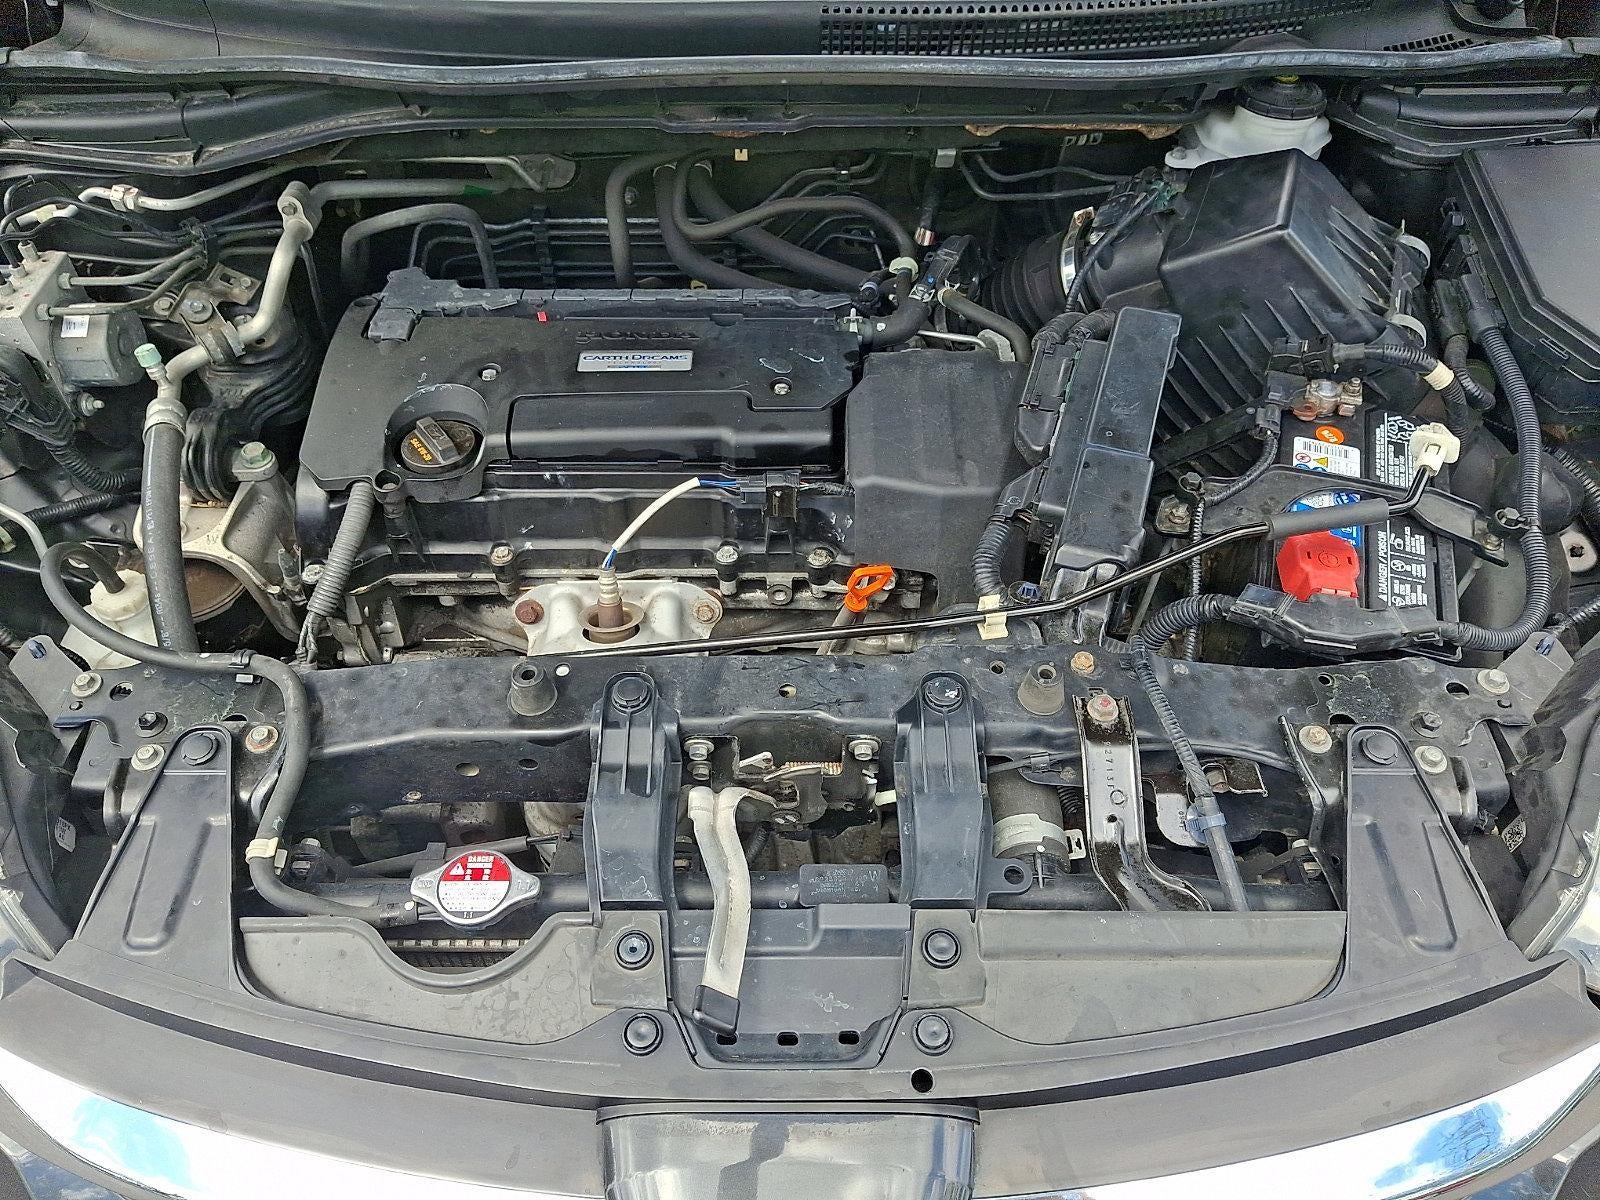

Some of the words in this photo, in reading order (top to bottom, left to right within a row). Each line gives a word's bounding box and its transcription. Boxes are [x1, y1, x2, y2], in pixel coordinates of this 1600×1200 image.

[1377, 530, 1388, 558] POISON
[1378, 563, 1388, 594] DANGER
[467, 855, 495, 863] DANGER
